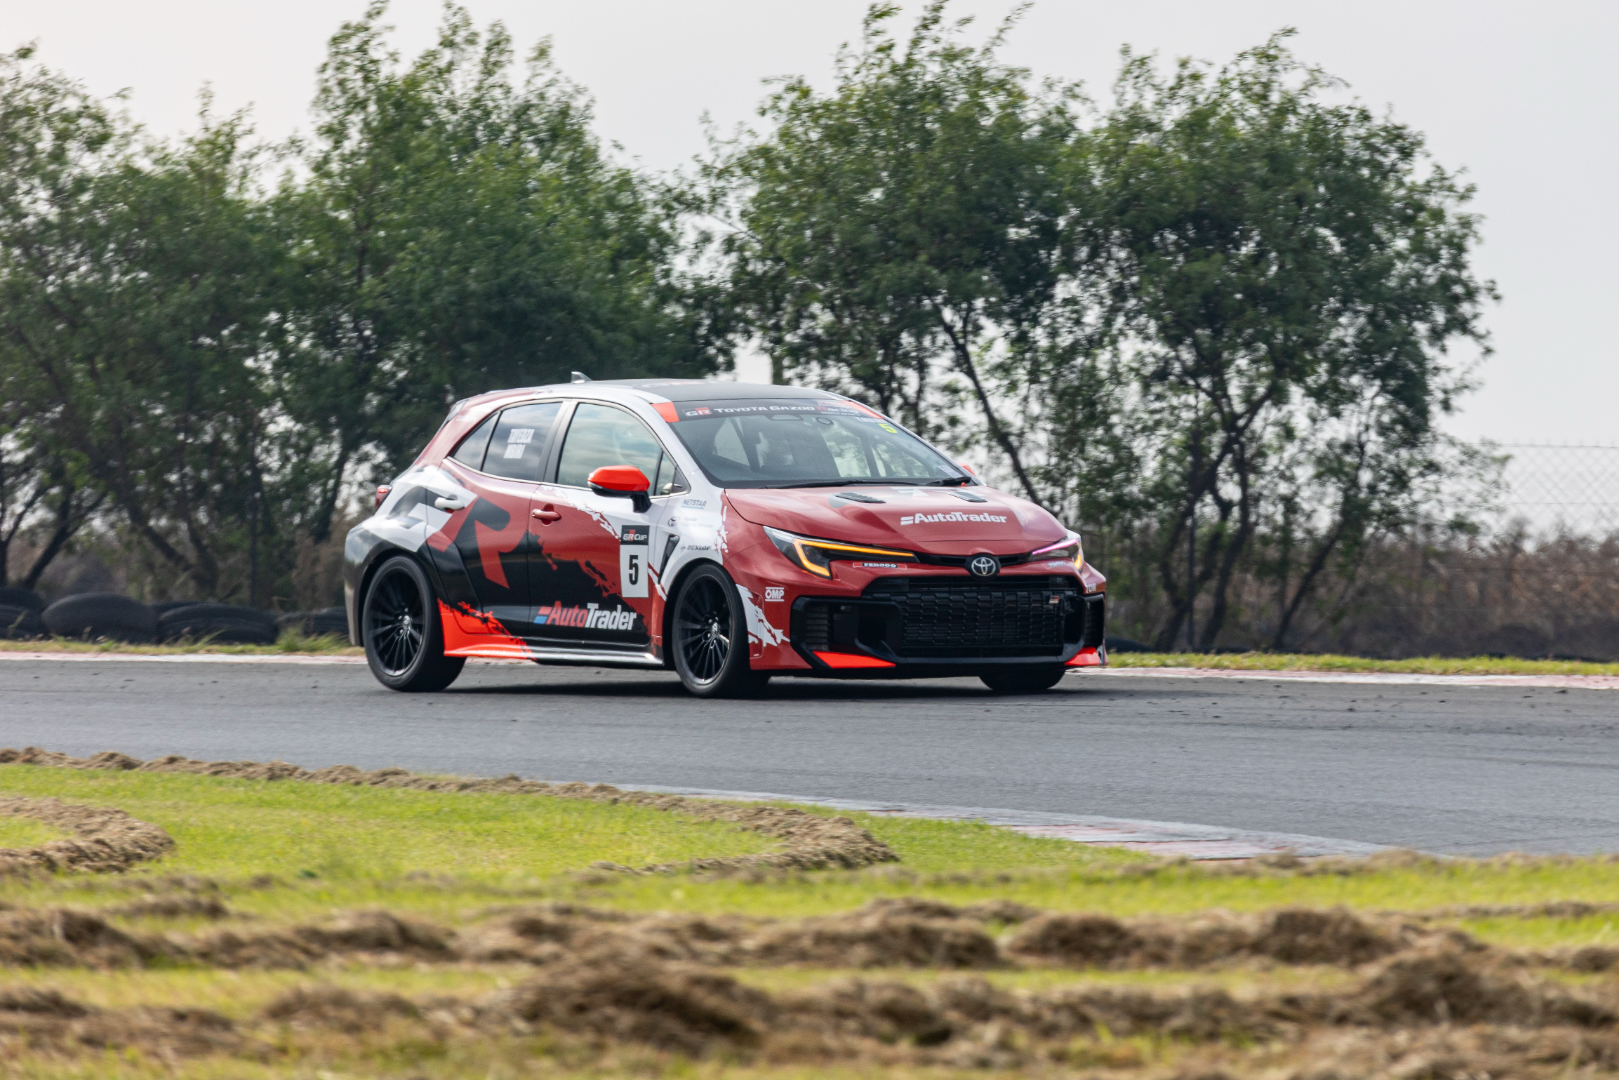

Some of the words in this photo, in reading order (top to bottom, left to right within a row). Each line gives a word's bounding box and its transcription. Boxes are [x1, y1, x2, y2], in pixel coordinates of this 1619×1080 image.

[878, 423, 898, 434] 5
[682, 499, 707, 507] NETSTAR
[914, 511, 1007, 524] AutoTrader
[628, 554, 639, 586] 5
[765, 588, 785, 600] OMP
[545, 600, 637, 630] AutoTrader
